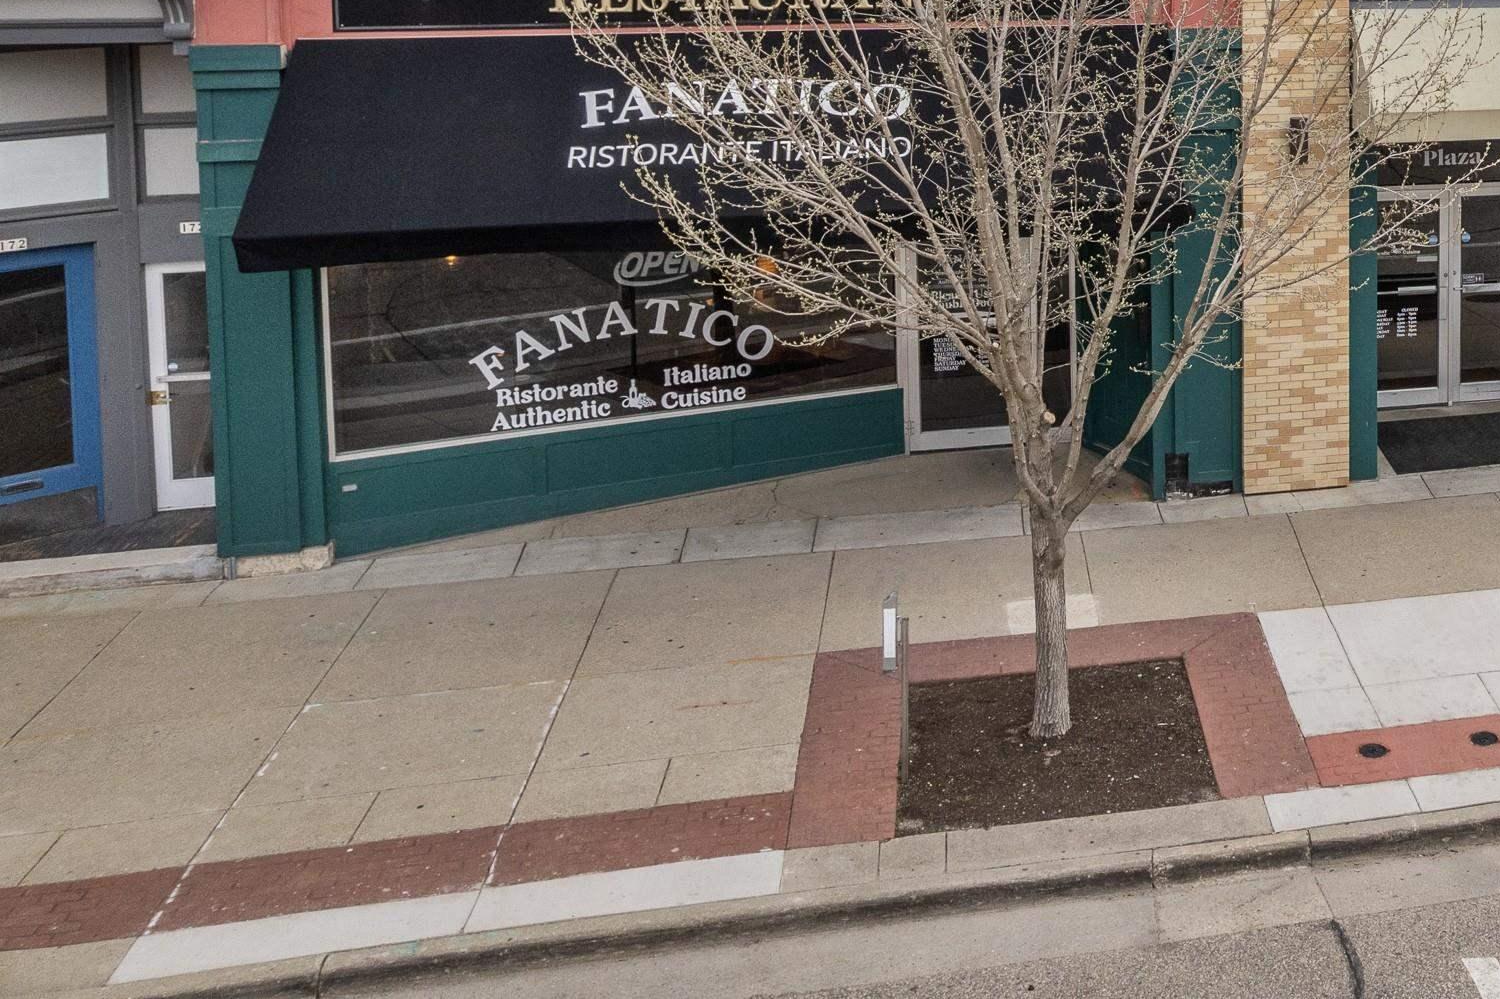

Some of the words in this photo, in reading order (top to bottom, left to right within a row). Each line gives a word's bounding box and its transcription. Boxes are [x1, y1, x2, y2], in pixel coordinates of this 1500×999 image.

[1424, 149, 1483, 167] Plaza
[620, 250, 706, 279] OPEN
[468, 299, 775, 391] FANATICO
[495, 376, 618, 407] Ristorante
[662, 362, 752, 388] Italiano
[490, 401, 611, 432] Authentic
[660, 384, 747, 410] Cuisine
